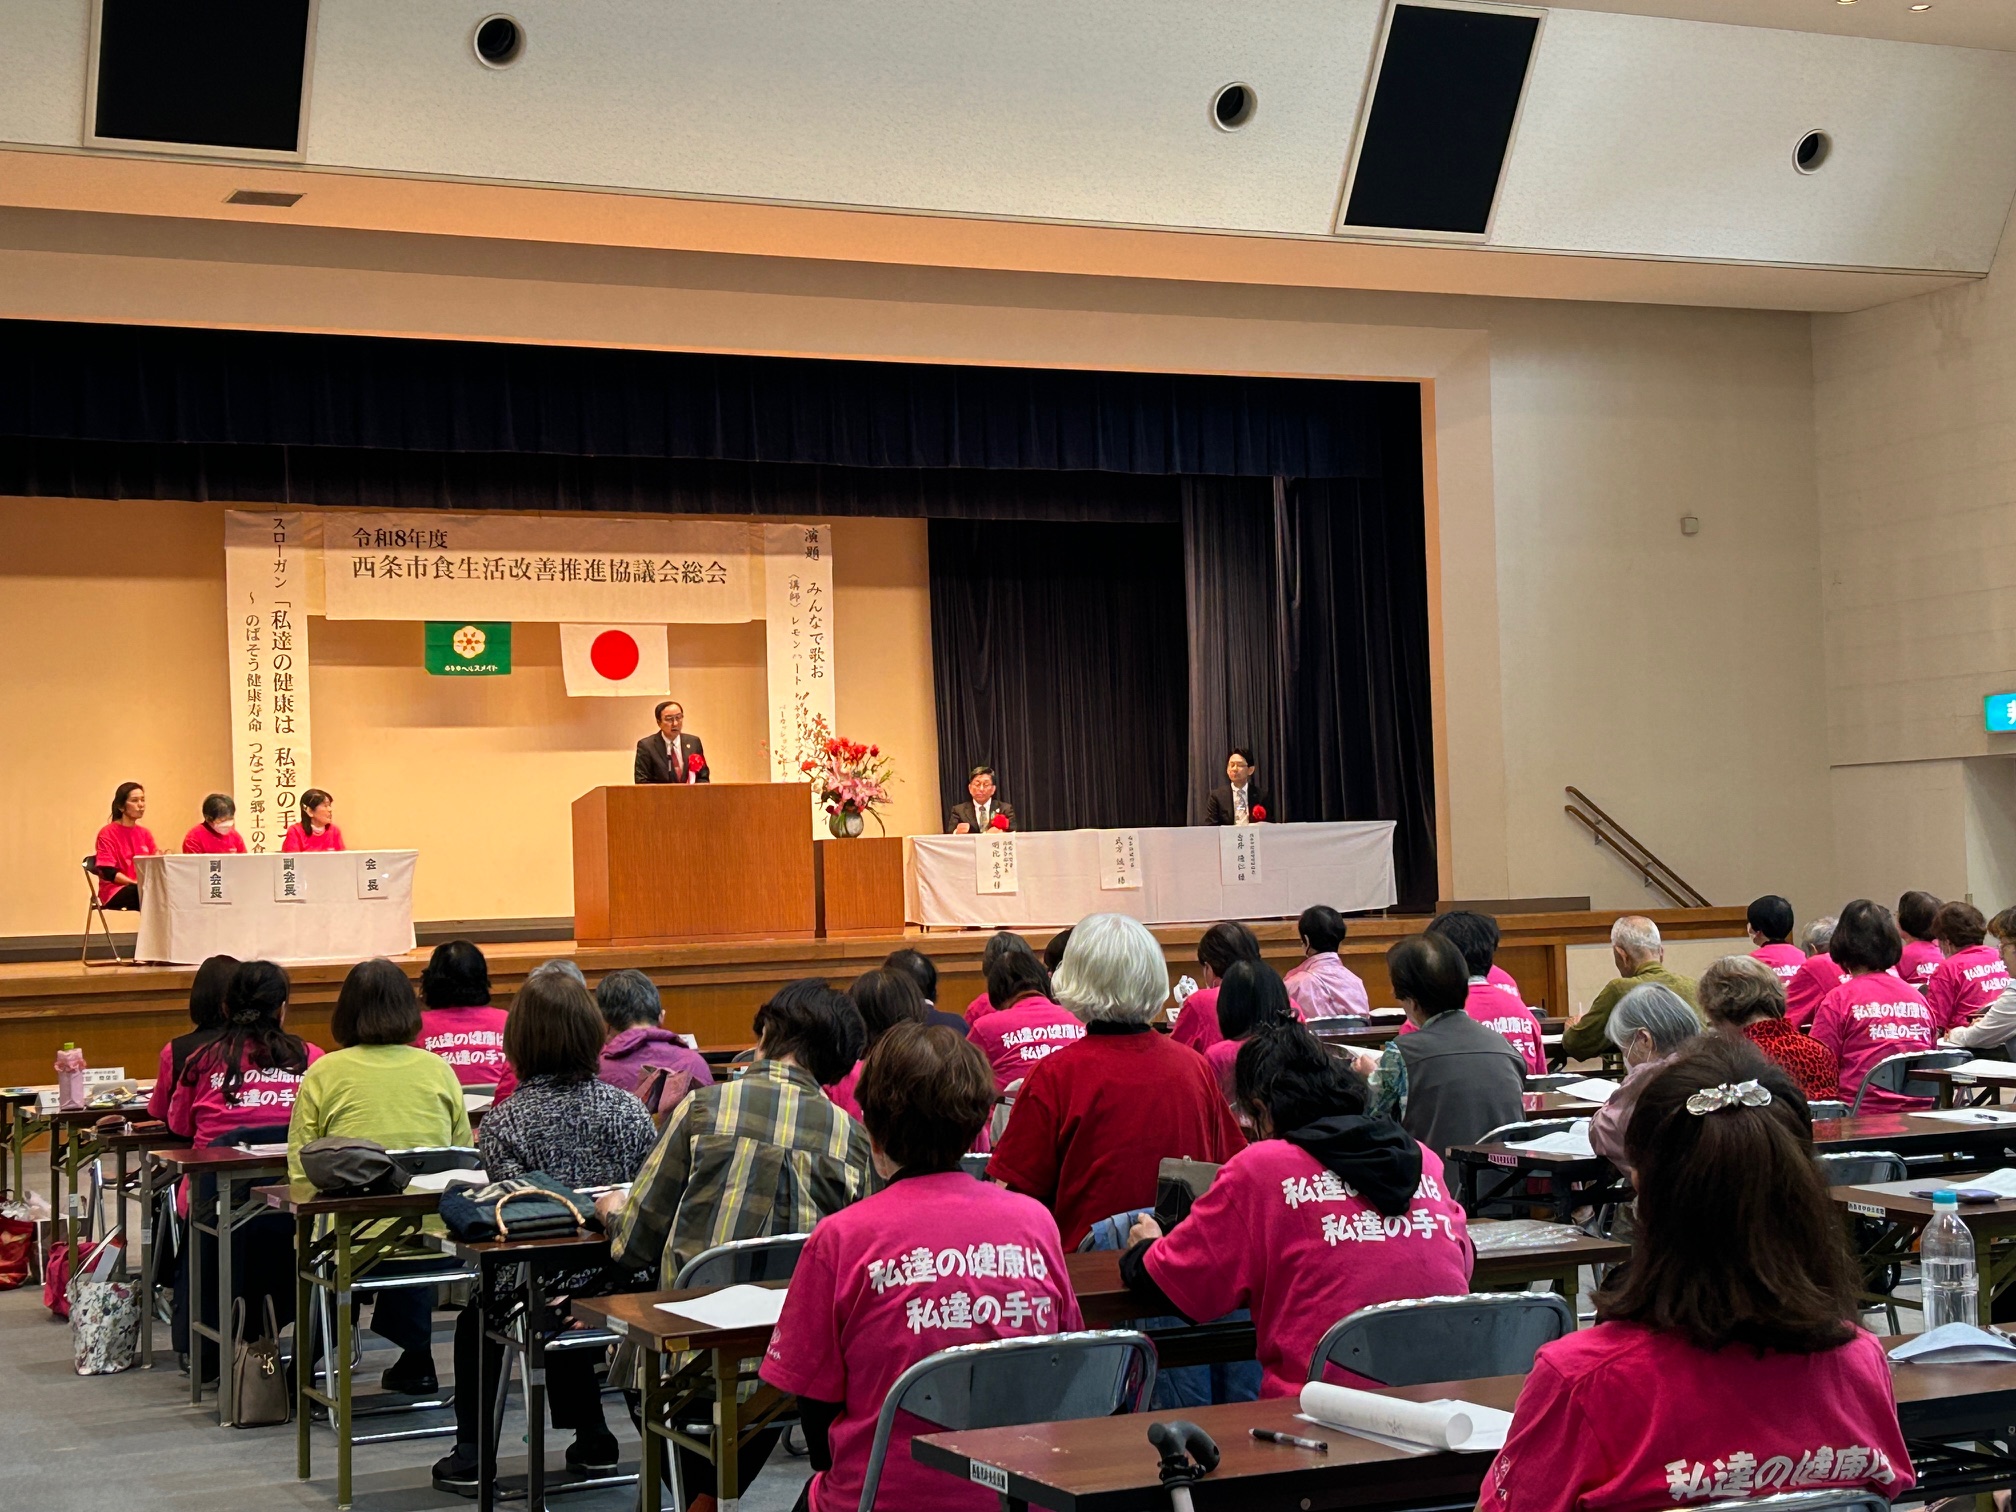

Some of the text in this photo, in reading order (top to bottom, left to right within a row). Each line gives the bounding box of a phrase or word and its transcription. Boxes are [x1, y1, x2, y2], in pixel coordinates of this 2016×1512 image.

[273, 518, 288, 588] スローガン
[351, 527, 449, 549] 令和8年度
[804, 528, 820, 561] 演題
[351, 555, 728, 585] 西条市食生活改善推進協議会総会
[245, 614, 263, 733] のばそう健康寿命
[271, 601, 295, 734] 「私達の健康は
[209, 860, 223, 899] 副会長
[282, 858, 297, 897] 副会長
[1852, 1001, 1930, 1021] 私達の健康は
[1869, 1022, 1931, 1043] 私達の手で
[867, 1242, 1048, 1295] 私達の健康は
[906, 1289, 1051, 1335] 私達の手で
[1664, 1445, 1897, 1501] 私達の健康は
